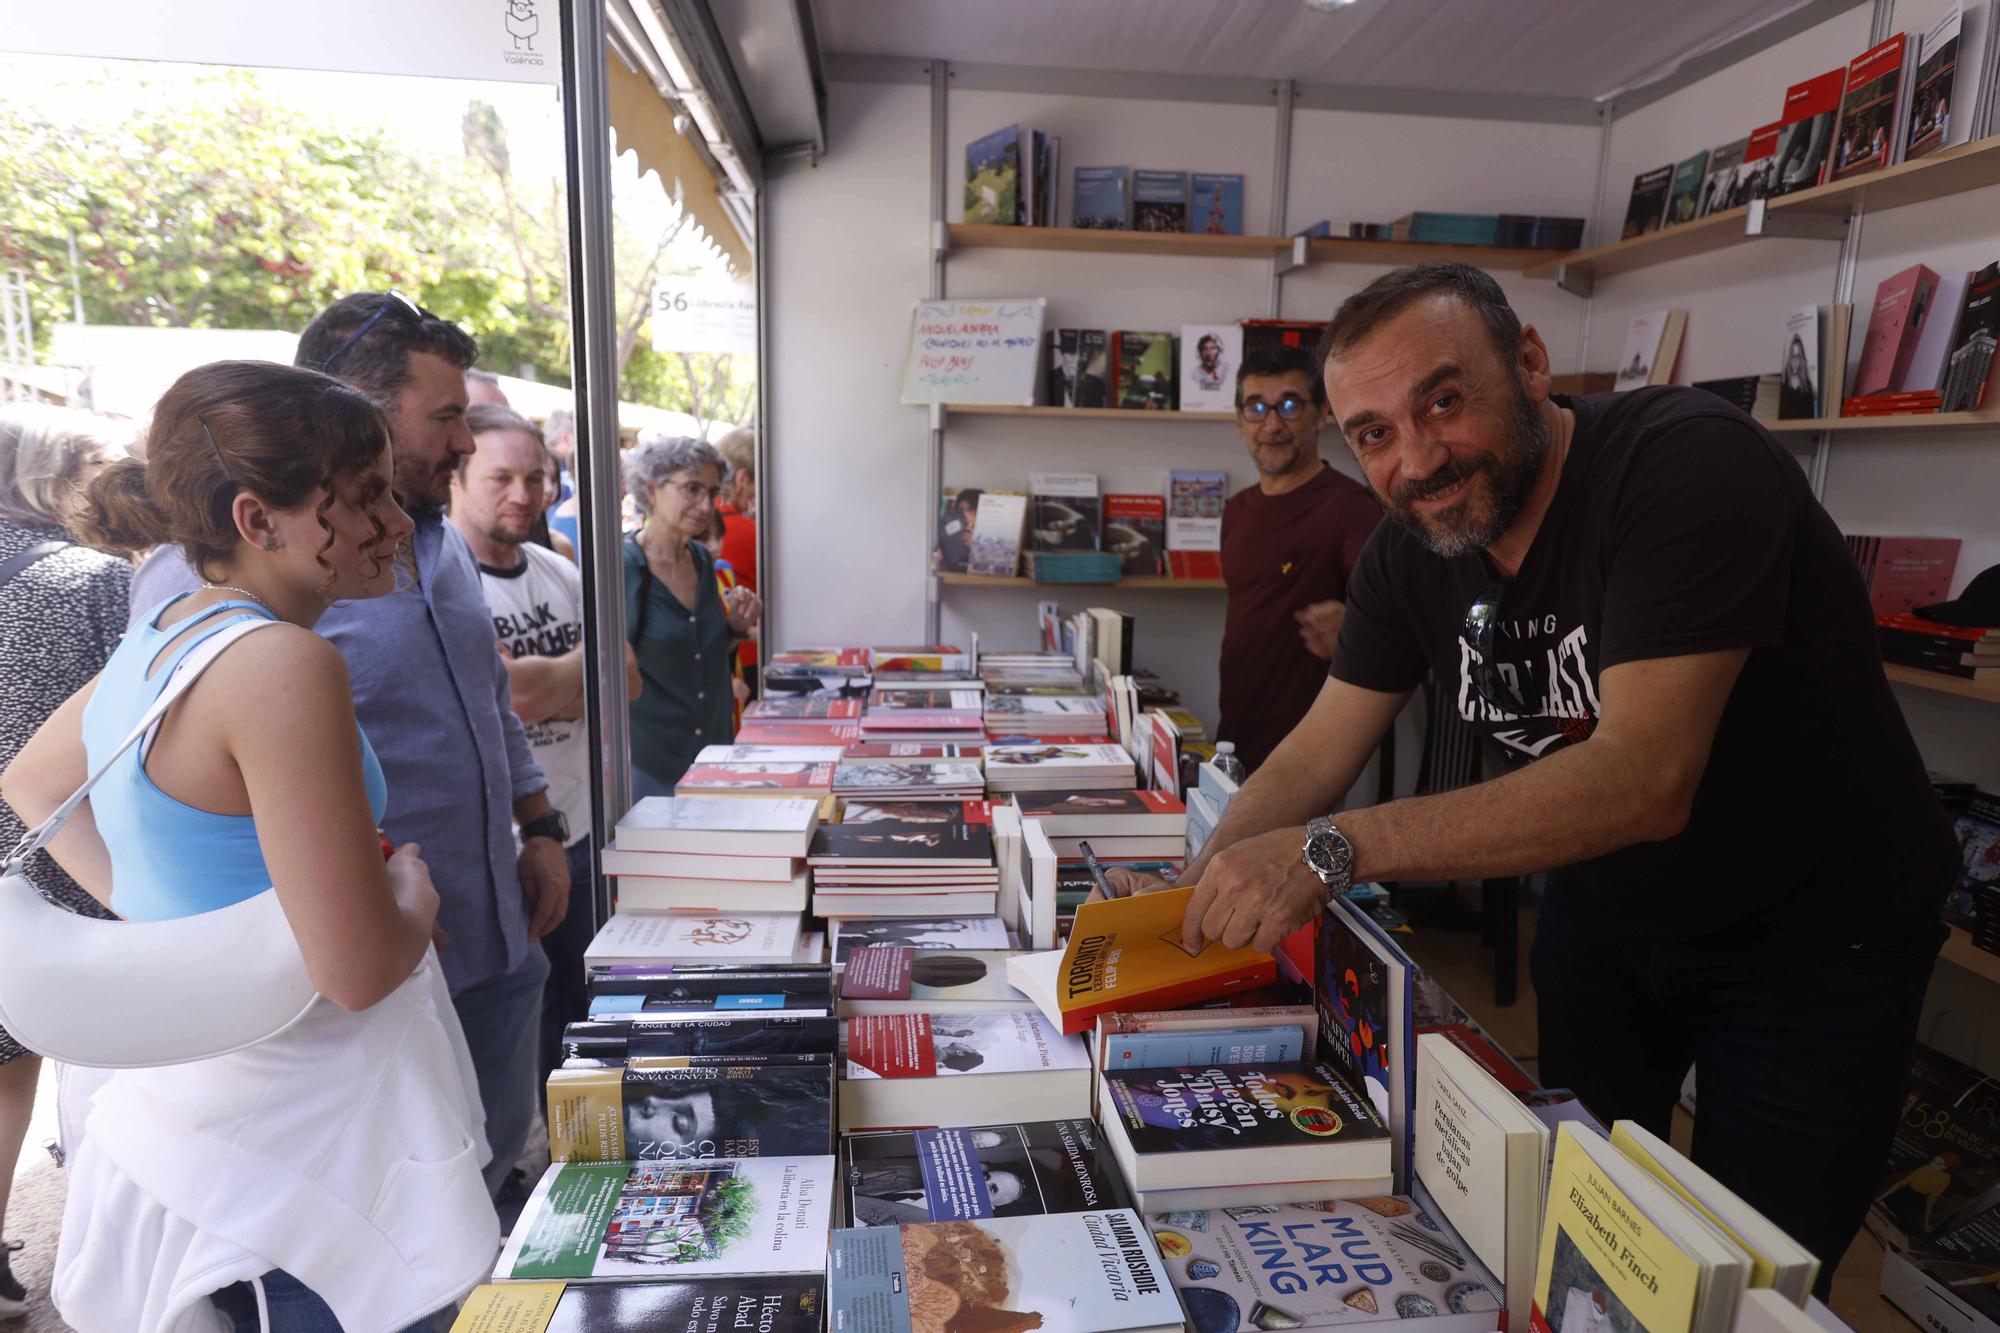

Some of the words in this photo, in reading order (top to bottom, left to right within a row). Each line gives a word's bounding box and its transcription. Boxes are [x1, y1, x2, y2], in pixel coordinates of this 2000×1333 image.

[658, 291, 688, 312] 56
[493, 601, 557, 639] BLAK
[1069, 936, 1106, 999] TORONTO
[1105, 965, 1117, 989] FELIP
[1156, 1080, 1198, 1128] Jones
[1187, 1076, 1240, 1135] Daisy
[1201, 1069, 1258, 1128] quieren
[1240, 1071, 1285, 1120] Todos
[599, 1113, 608, 1136] PUEDE
[1348, 1102, 1368, 1120] Reid
[1434, 1099, 1471, 1151] Persianas
[1902, 1103, 1949, 1138] 58
[1055, 1121, 1070, 1136] UNA
[1078, 1130, 1096, 1151] Vuillard
[1434, 1118, 1471, 1167] metálicas
[960, 1150, 968, 1166] maneras
[1061, 1135, 1080, 1160] SALIDA
[1441, 1139, 1462, 1173] bajan
[784, 1165, 798, 1173] La
[936, 1166, 946, 1182] Vuillard
[954, 1164, 962, 1172] más
[956, 1172, 966, 1193] honrosas
[1072, 1160, 1099, 1206] HONROSA
[1436, 1151, 1446, 1168] de
[1446, 1166, 1469, 1196] golpe
[780, 1174, 797, 1199] librería
[800, 1178, 815, 1196] Alba
[940, 1188, 949, 1204] única.
[946, 1168, 954, 1186] maneras
[952, 1193, 962, 1216] contarlo,
[959, 1193, 968, 1202] que
[965, 1172, 976, 1196] abandonar
[778, 1200, 788, 1210] en
[794, 1199, 812, 1229] Donati
[971, 1196, 978, 1204] un
[971, 1204, 982, 1216] país
[1586, 1172, 1612, 1205] JULIAN
[1611, 1200, 1642, 1237] BARNES
[580, 1217, 594, 1242] convertido
[777, 1212, 791, 1221] la
[772, 1222, 788, 1252] colina
[1082, 1214, 1116, 1250] Ciudad
[1568, 1187, 1618, 1251] Elizabeth
[1618, 1246, 1660, 1294] Finch
[1104, 1213, 1140, 1248] SALMAN
[1122, 1249, 1161, 1296] RUSHDIE
[1221, 1224, 1234, 1244] Historia
[1234, 1248, 1248, 1270] objetos
[1244, 1270, 1263, 1298] perdidos
[1238, 1221, 1308, 1295] KING
[1282, 1224, 1348, 1286] LAR
[1320, 1217, 1393, 1286] MUD
[1362, 1214, 1384, 1236] LARA
[1384, 1240, 1421, 1286] MAIKLEM
[1098, 1252, 1132, 1302] Victoria
[1228, 1260, 1244, 1283] Támesis
[690, 1296, 708, 1318] todo
[710, 1296, 728, 1321] Salvo
[734, 1296, 758, 1328] Abad
